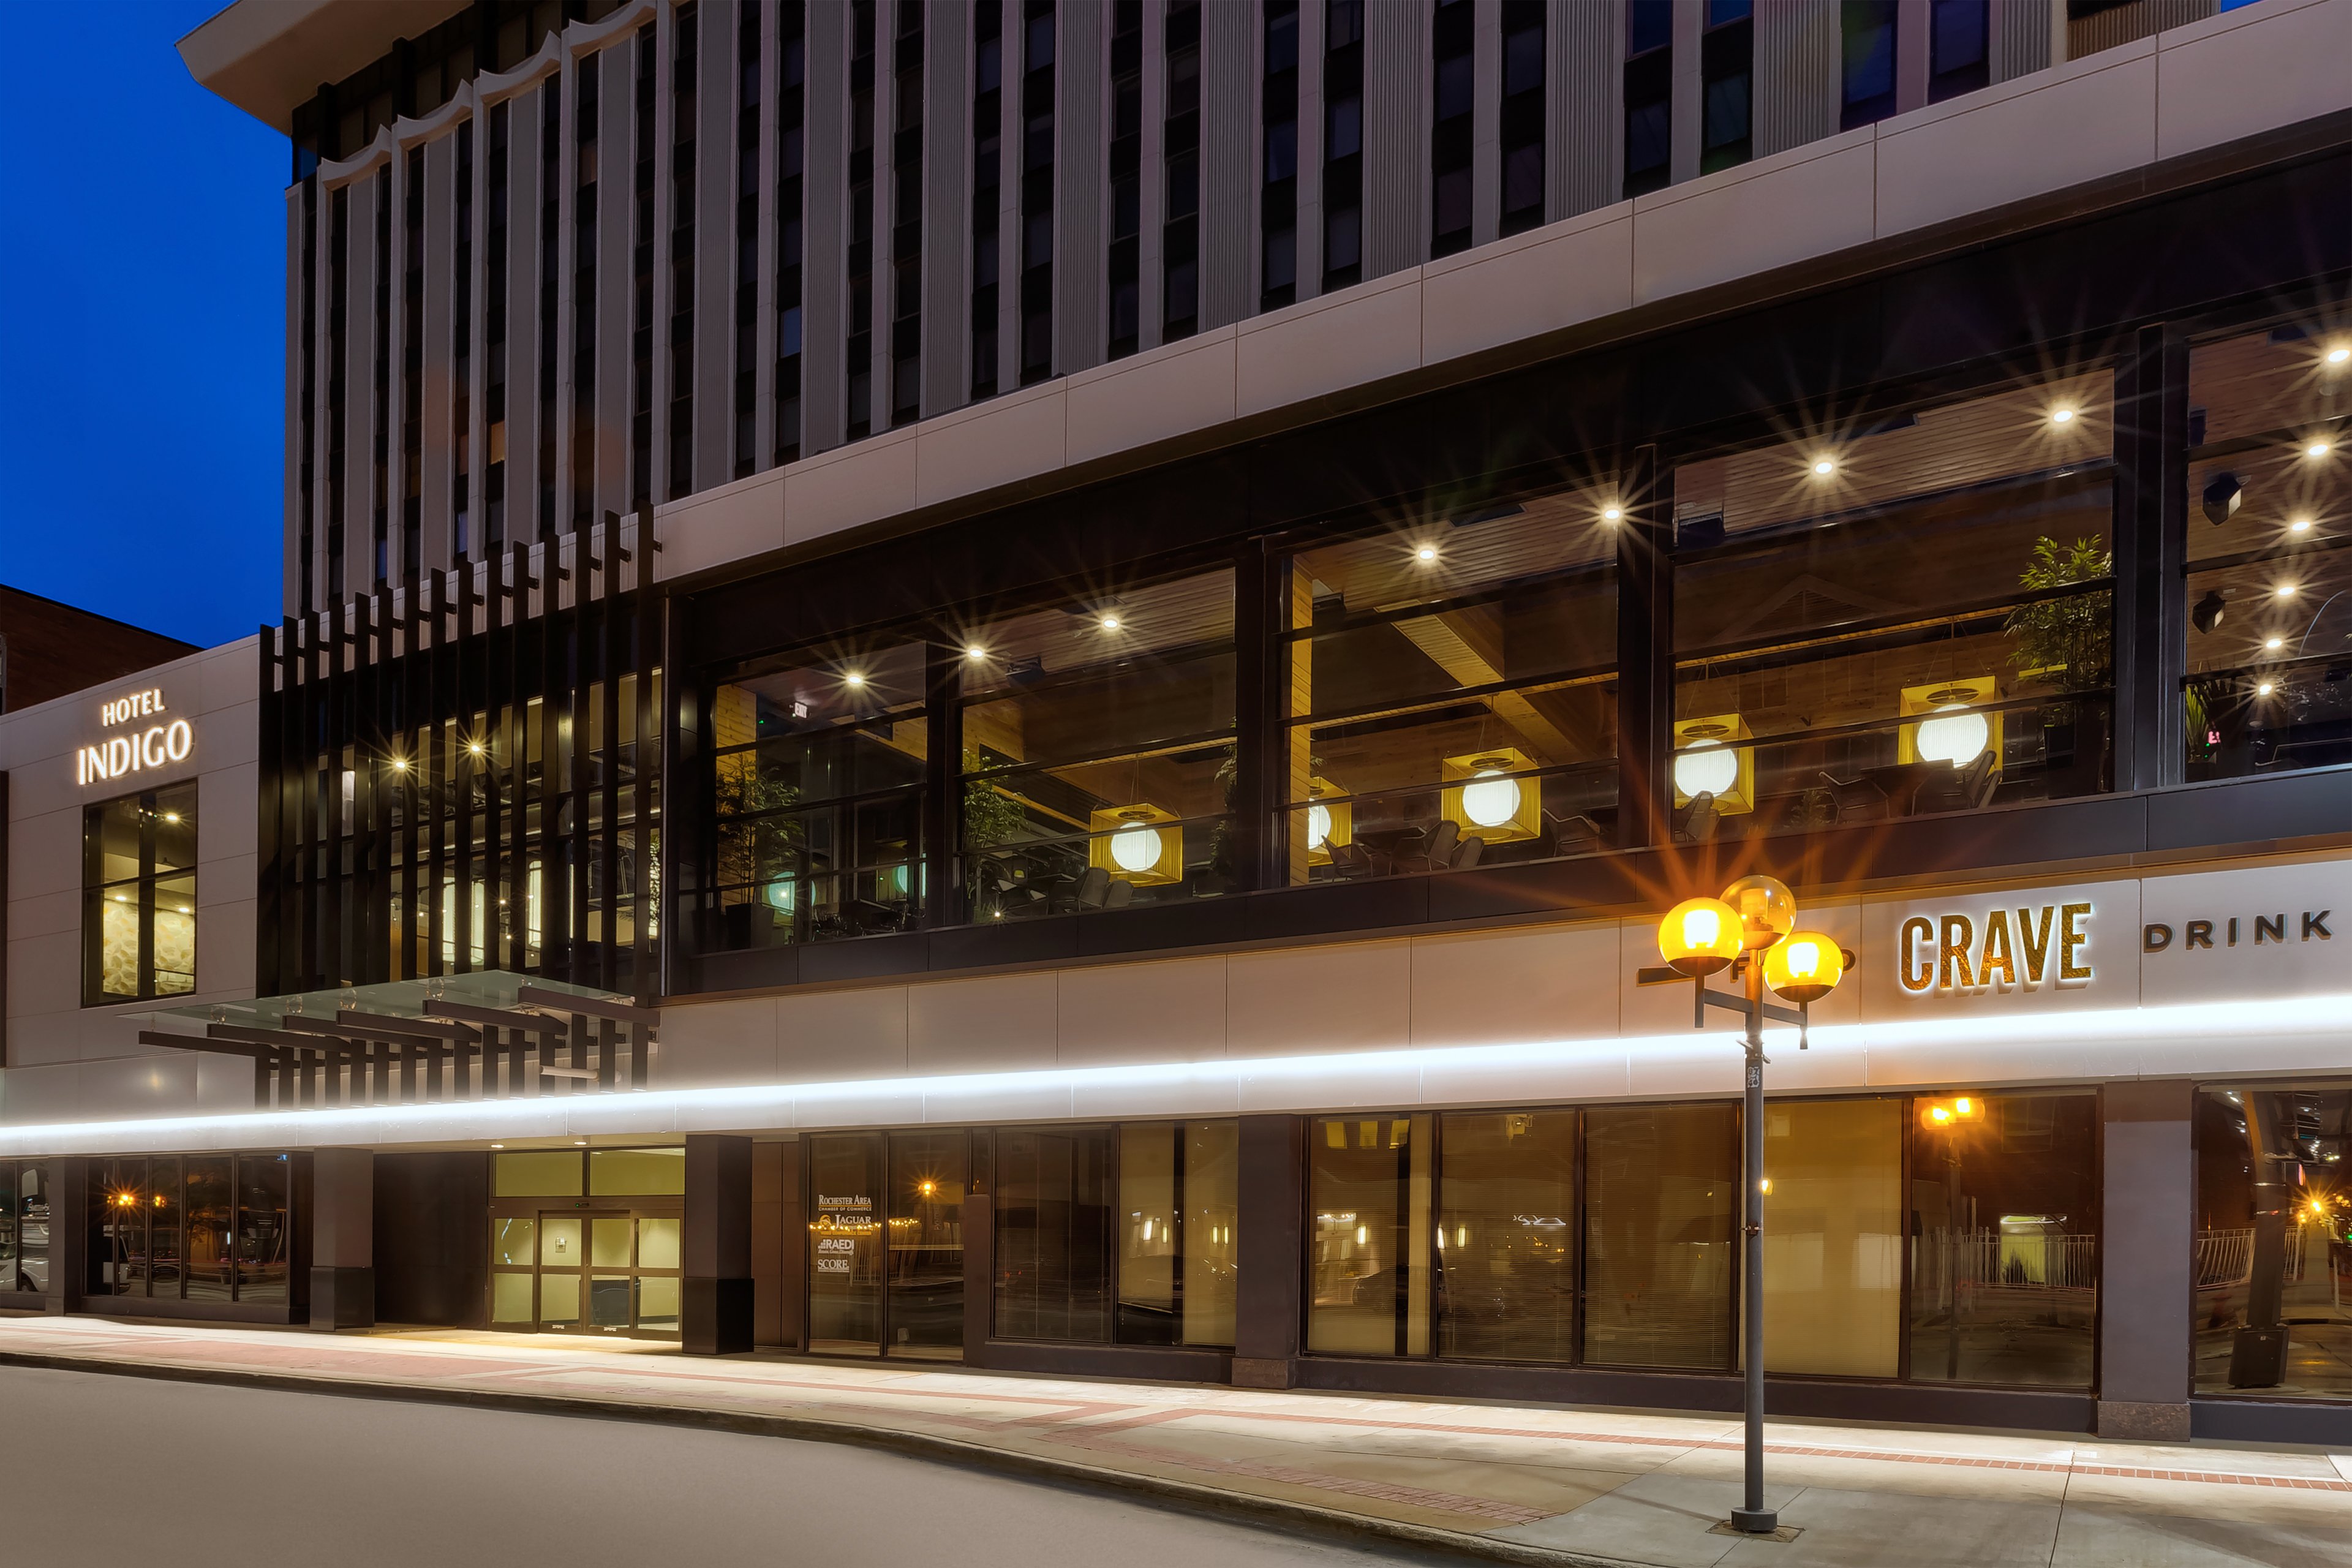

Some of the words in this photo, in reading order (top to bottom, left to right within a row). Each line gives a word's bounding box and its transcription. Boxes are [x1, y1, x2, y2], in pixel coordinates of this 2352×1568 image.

[102, 687, 167, 728] HOTEL
[78, 719, 194, 786] INDIGO
[1901, 902, 2092, 992] CRAVE
[2143, 910, 2333, 954] DRINK
[854, 1194, 872, 1205] AREA
[835, 1215, 872, 1229] JAGUAR
